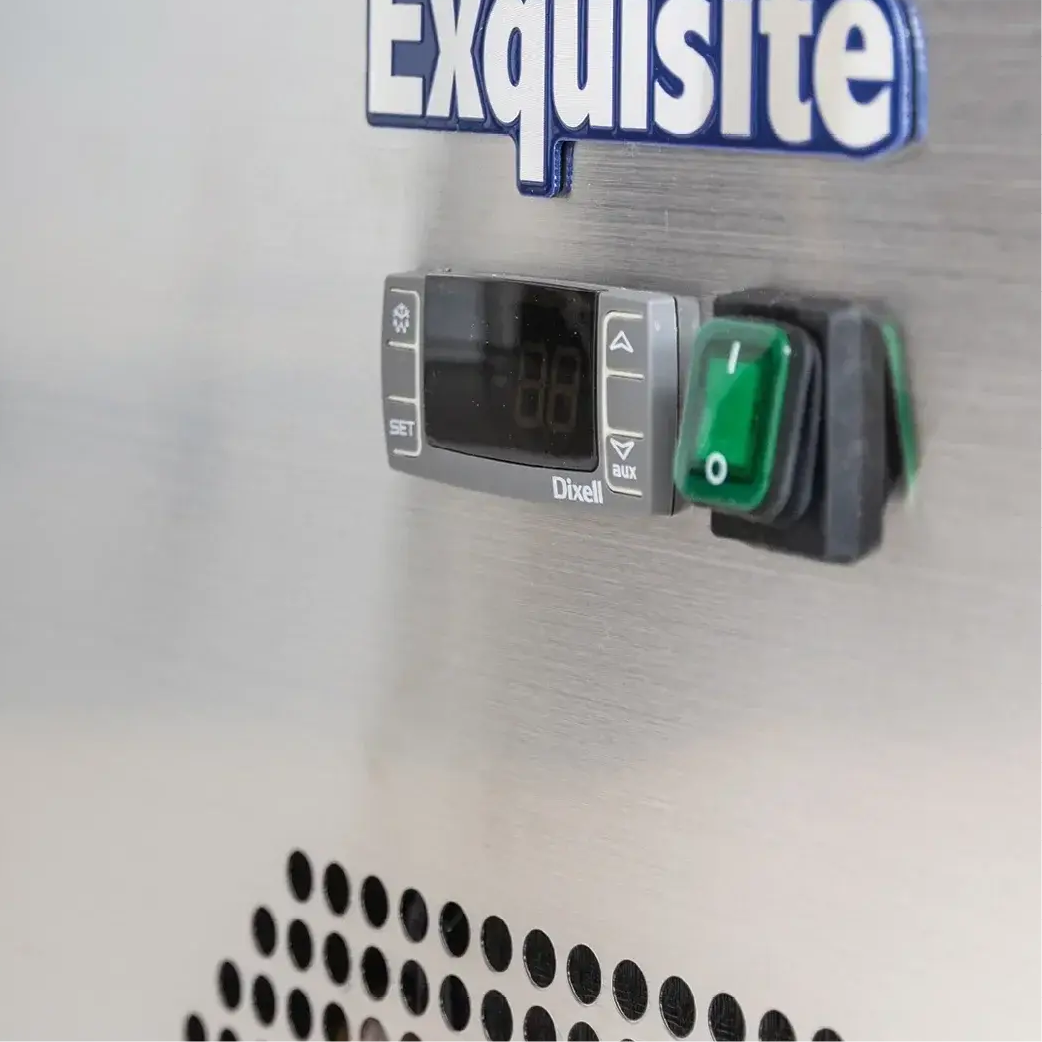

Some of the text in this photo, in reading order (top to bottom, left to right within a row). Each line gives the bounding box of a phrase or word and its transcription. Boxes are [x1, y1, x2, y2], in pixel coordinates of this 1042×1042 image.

[389, 418, 416, 437] SET
[612, 463, 638, 480] aux
[551, 475, 604, 504] Dixell
